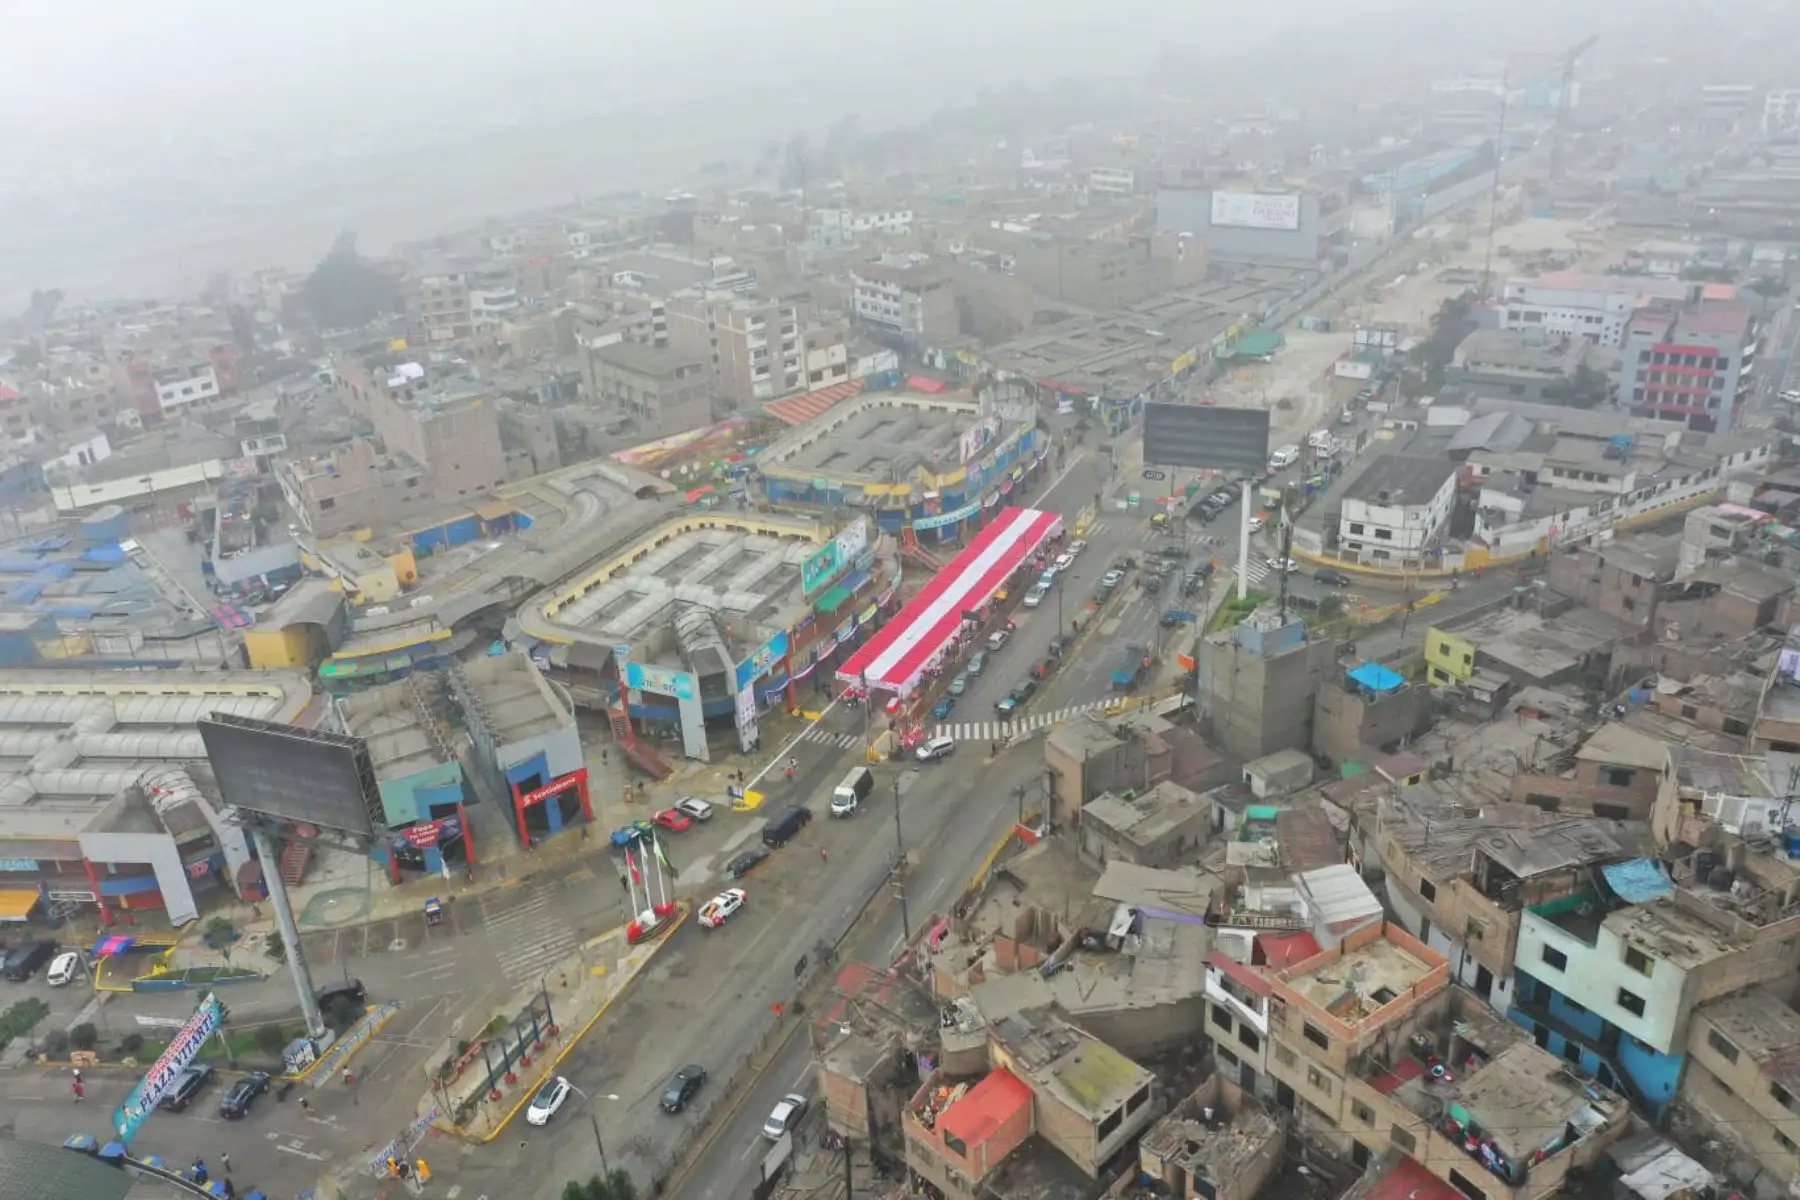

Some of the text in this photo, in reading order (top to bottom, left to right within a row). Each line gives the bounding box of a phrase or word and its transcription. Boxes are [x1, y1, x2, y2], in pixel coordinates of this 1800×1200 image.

[533, 777, 576, 801] Scotiabank
[139, 1065, 175, 1111] PLAZA
[174, 1011, 218, 1066] VITARTE
